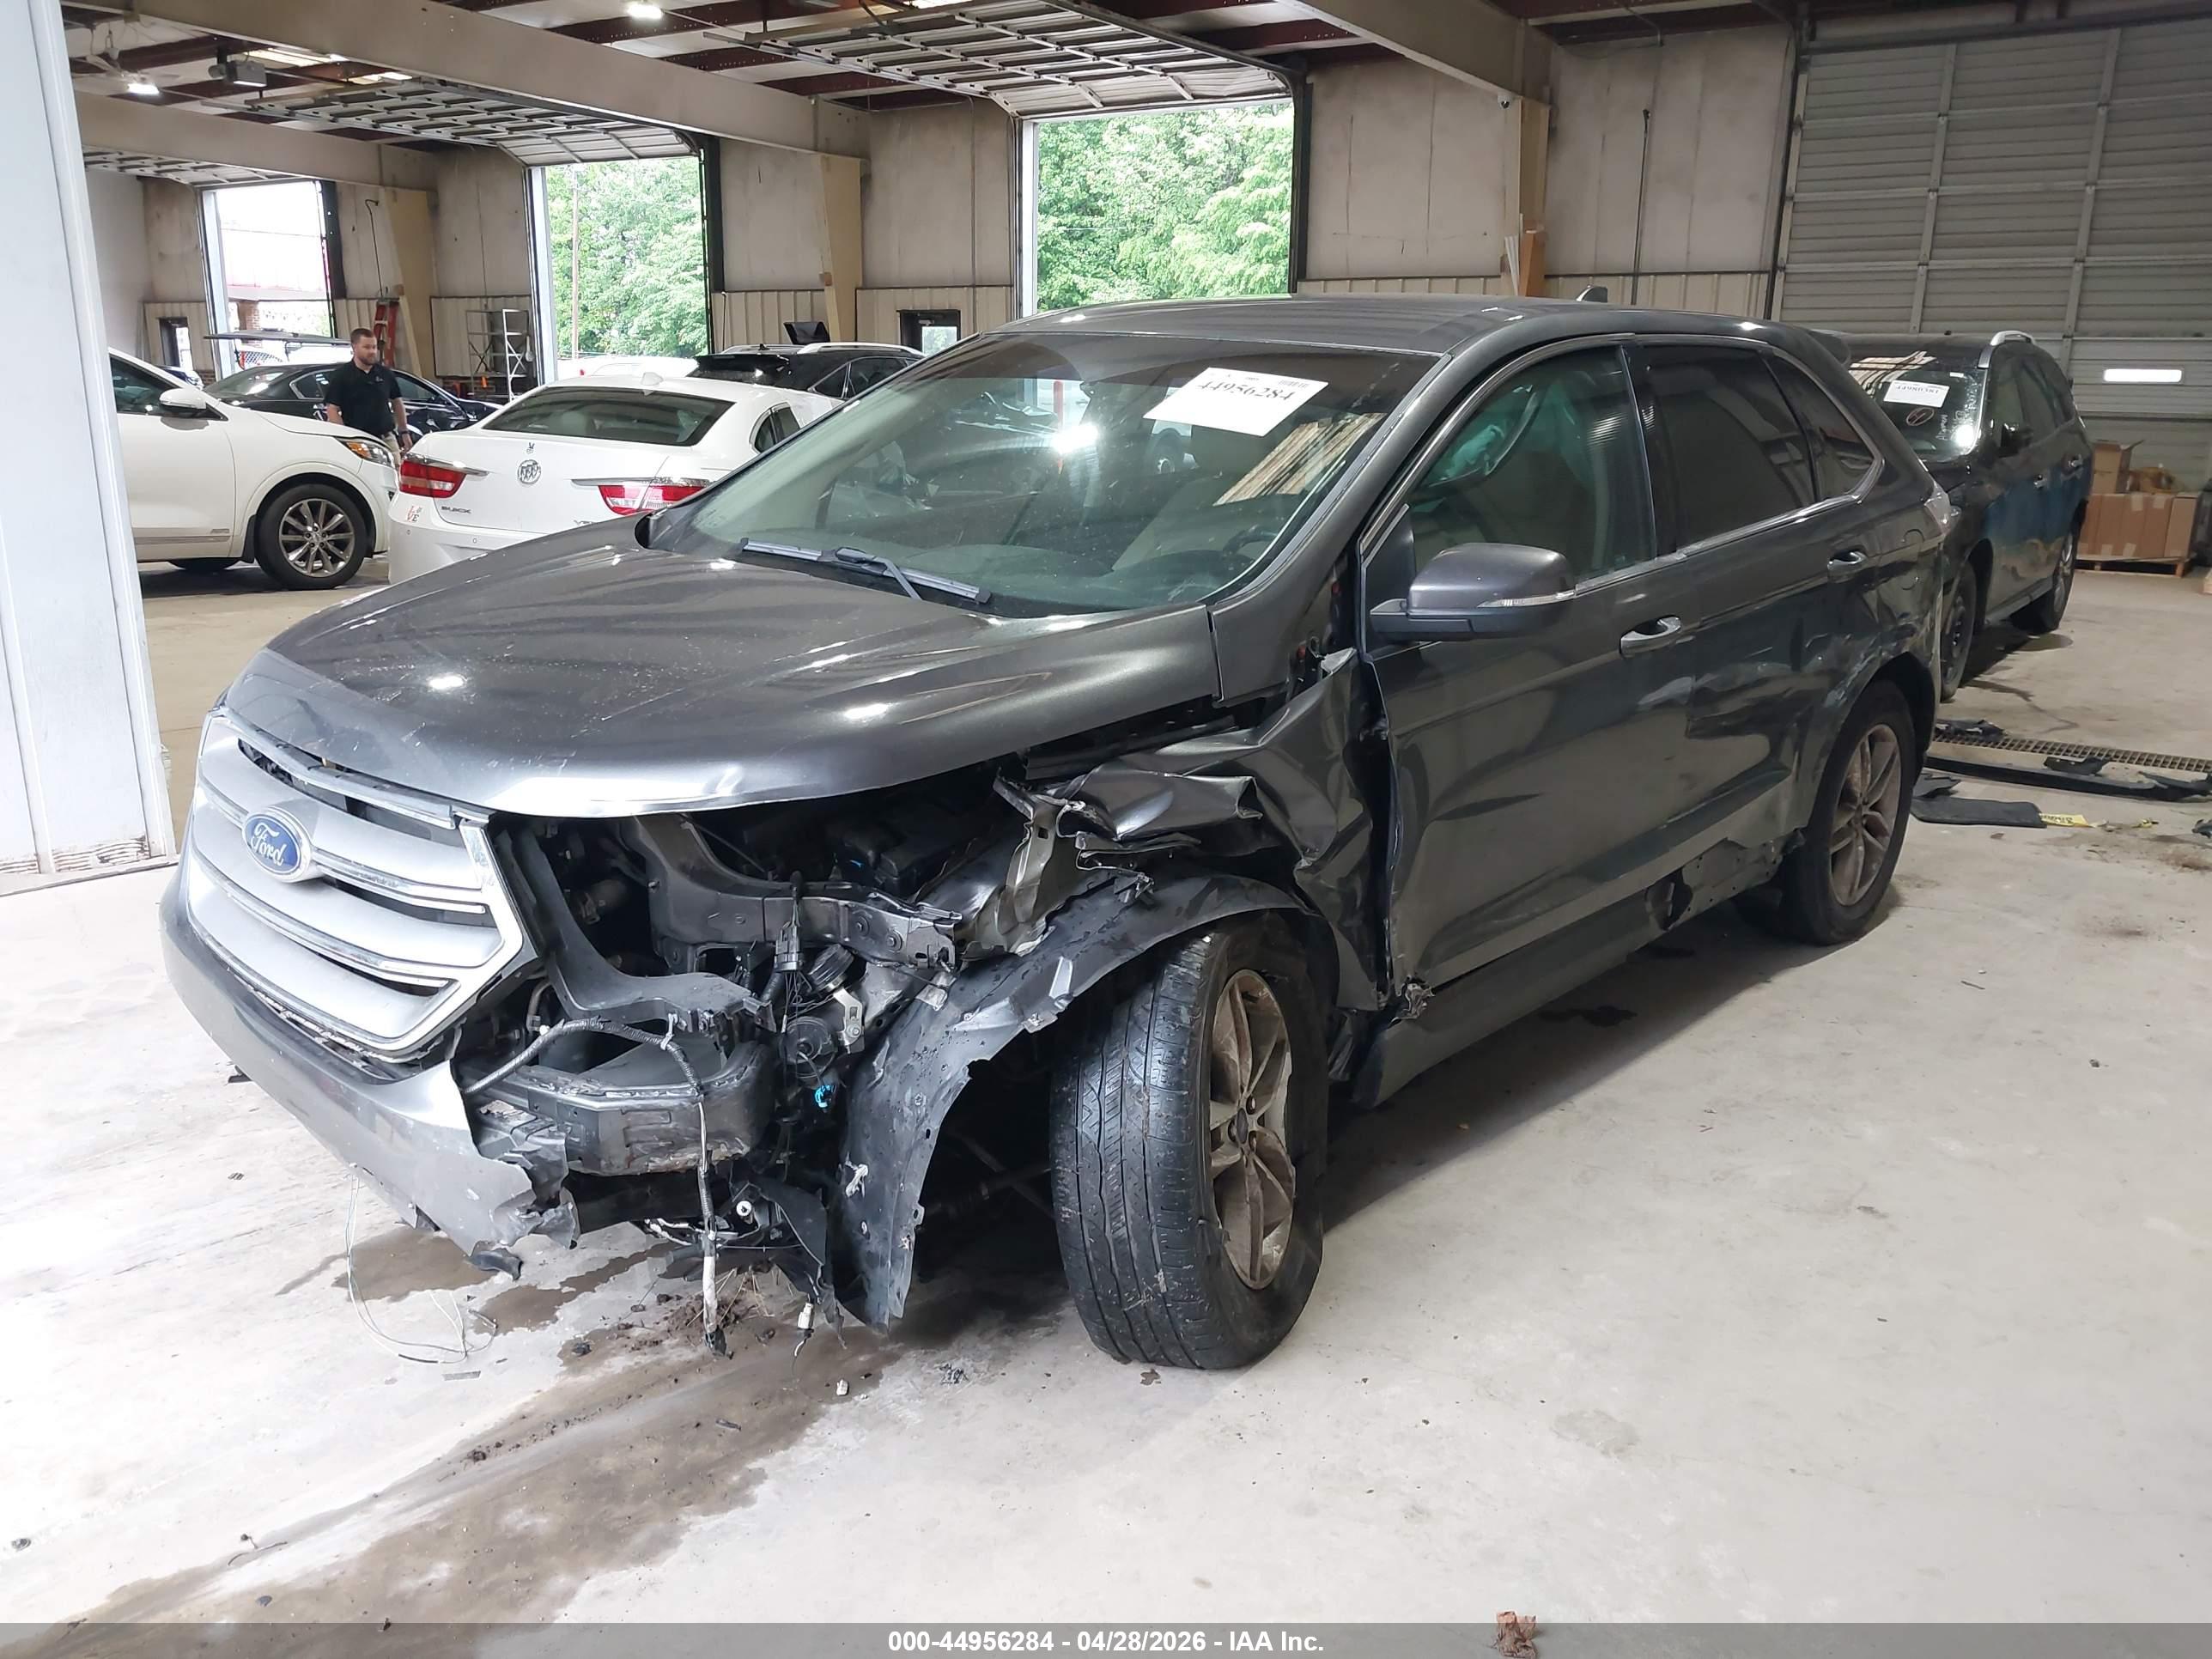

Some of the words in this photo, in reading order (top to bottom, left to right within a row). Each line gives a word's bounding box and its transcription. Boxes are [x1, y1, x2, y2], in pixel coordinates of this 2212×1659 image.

[1199, 381, 1295, 400] 44956284
[441, 505, 471, 514] BUICK
[251, 823, 287, 866] Ford
